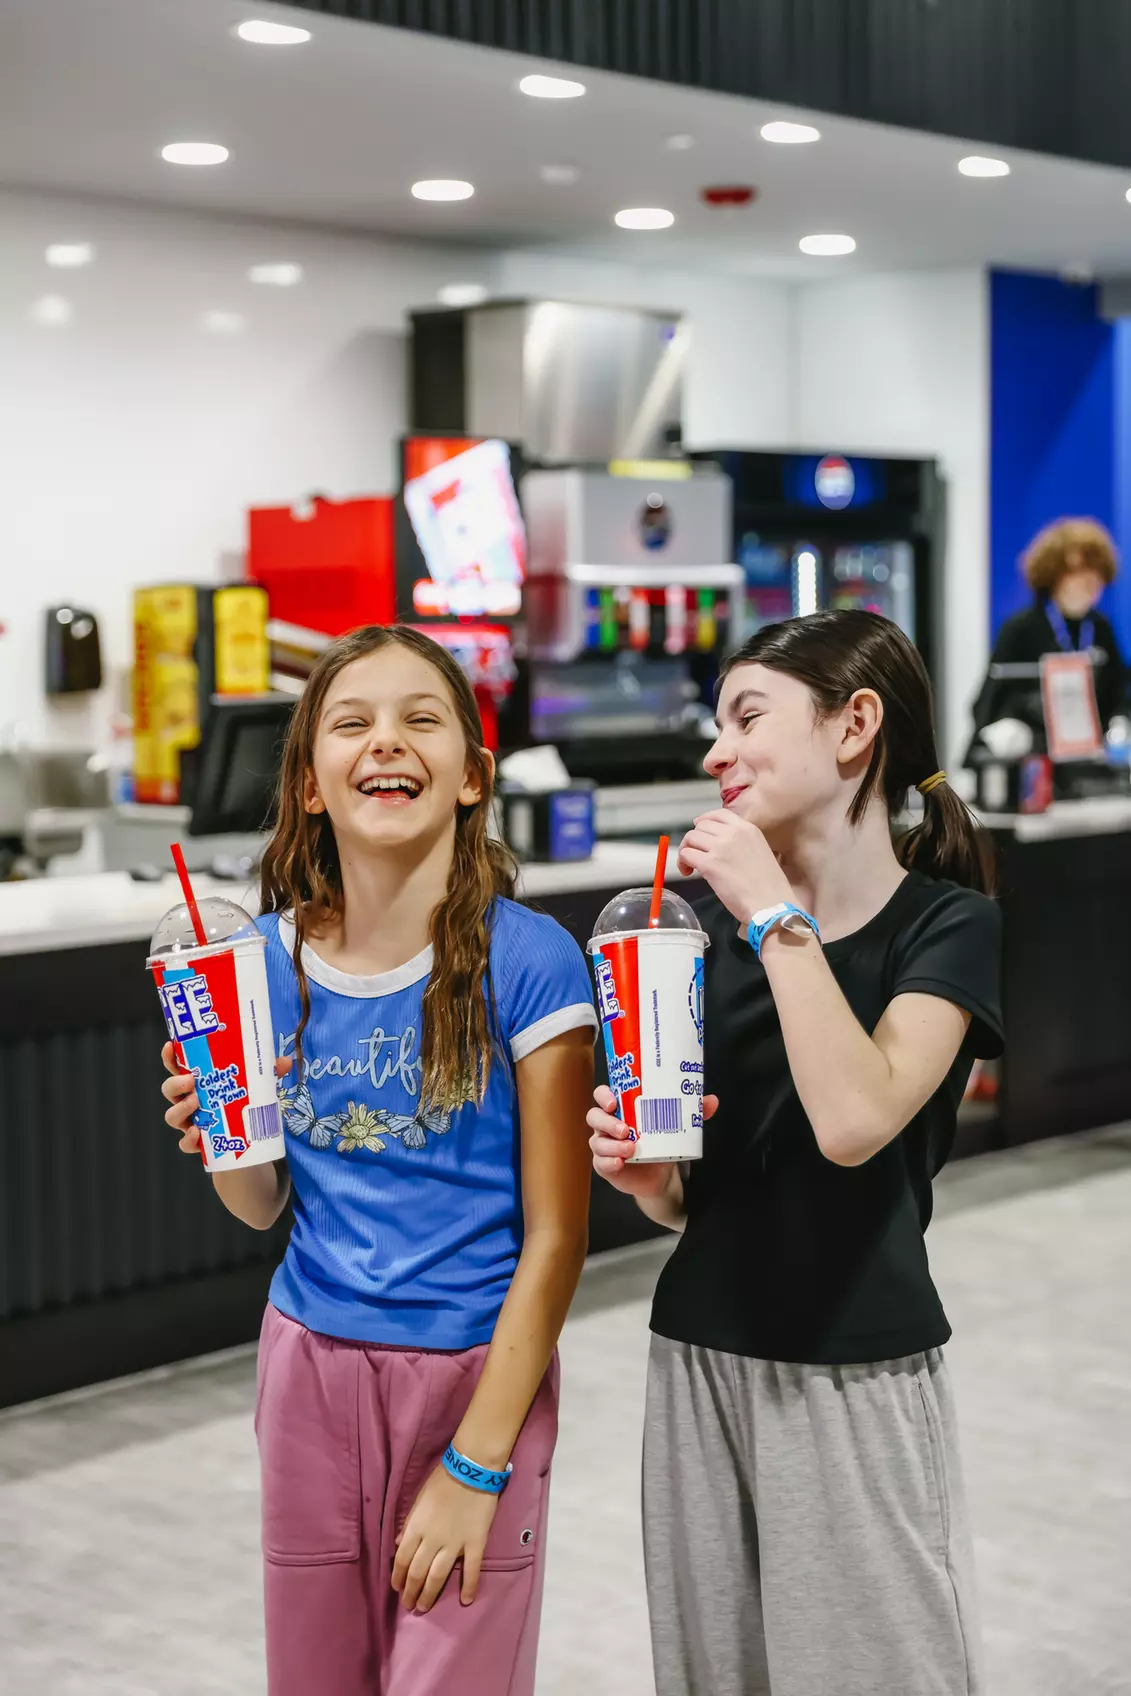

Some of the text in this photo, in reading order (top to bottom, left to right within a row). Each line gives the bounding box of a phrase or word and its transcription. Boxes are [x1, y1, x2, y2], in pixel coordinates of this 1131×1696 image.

[200, 1066, 238, 1088] Coldest
[618, 1078, 639, 1093] Town
[208, 1080, 236, 1098] Drink
[681, 1079, 694, 1095] Go
[208, 1089, 245, 1109] in Town
[445, 1448, 511, 1487] KY ZONE
